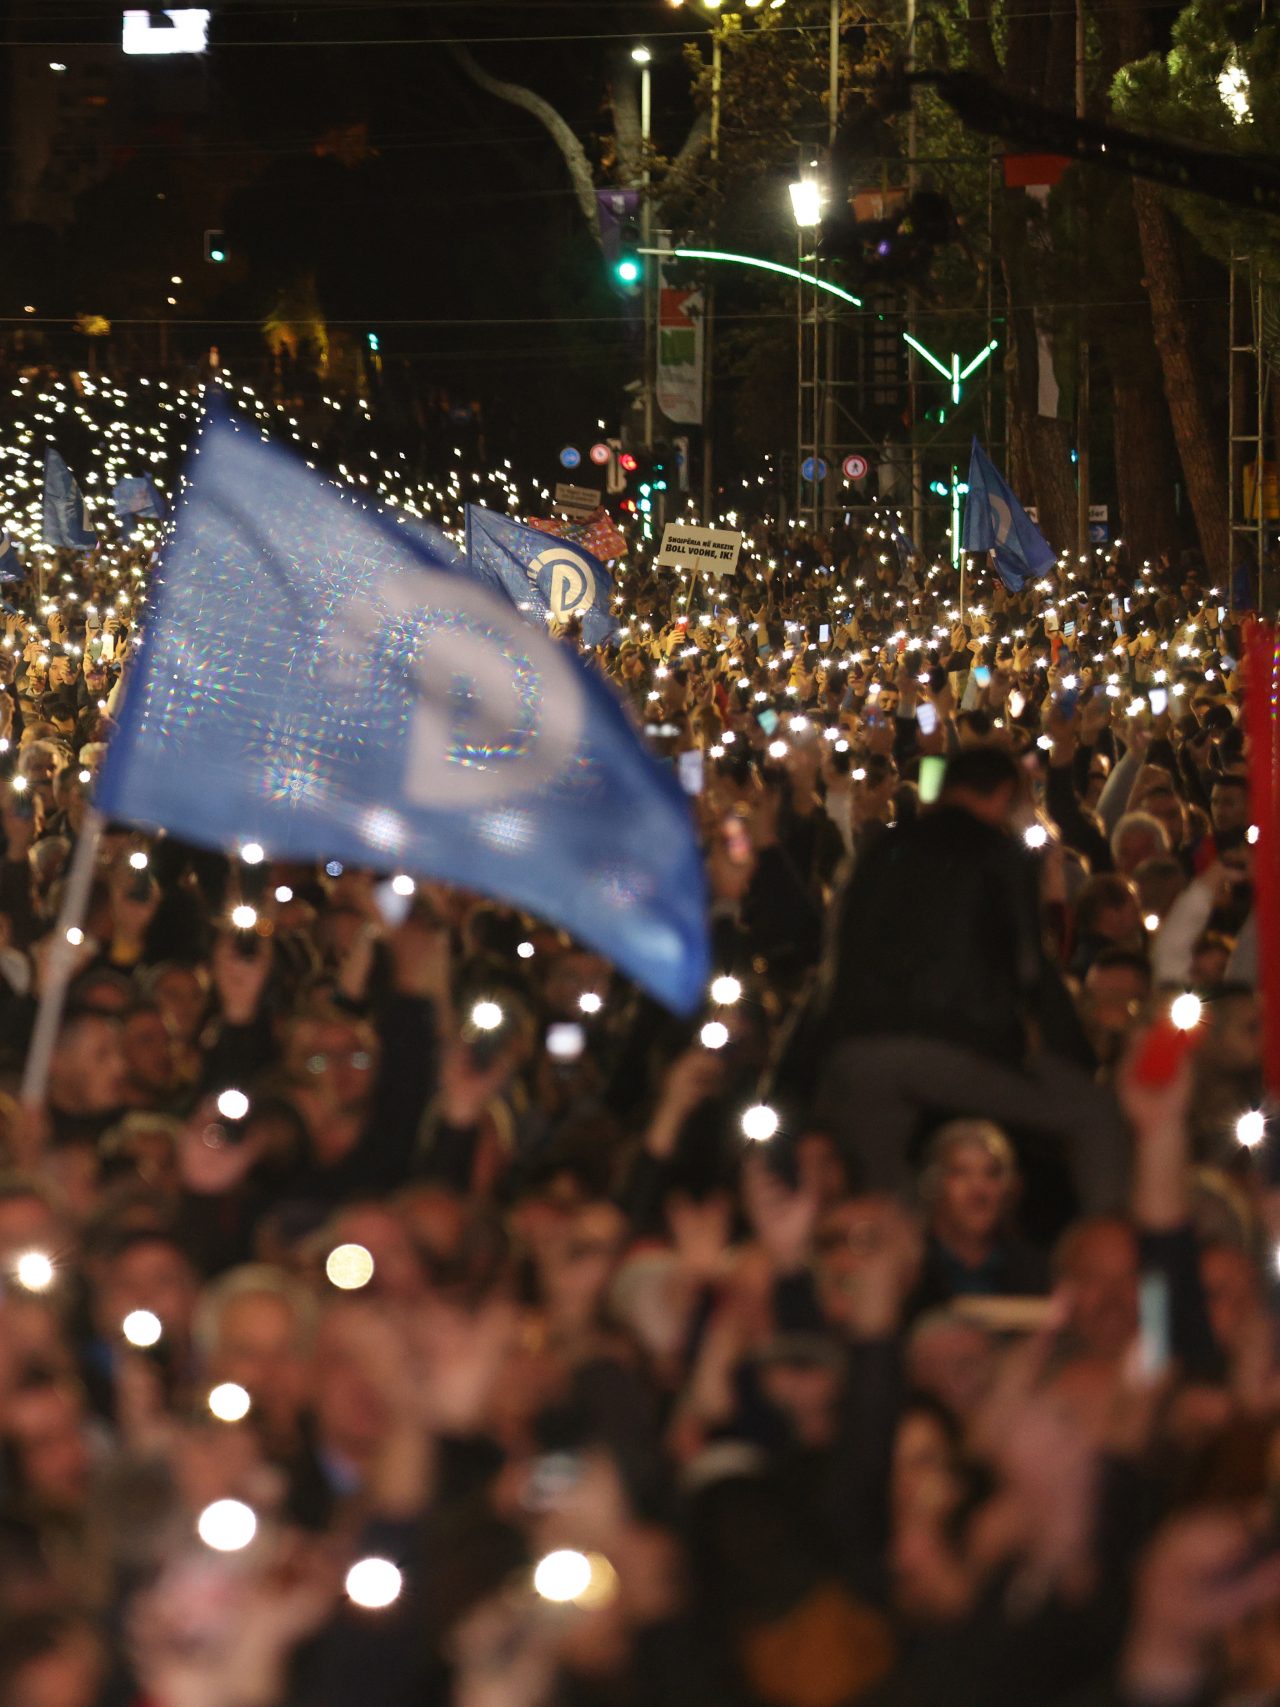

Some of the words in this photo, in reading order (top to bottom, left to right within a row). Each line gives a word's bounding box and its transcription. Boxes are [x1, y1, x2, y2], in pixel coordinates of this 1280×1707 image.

[665, 544, 686, 553] BOLL
[688, 547, 717, 559] VODHE,
[719, 551, 734, 560] IK!
